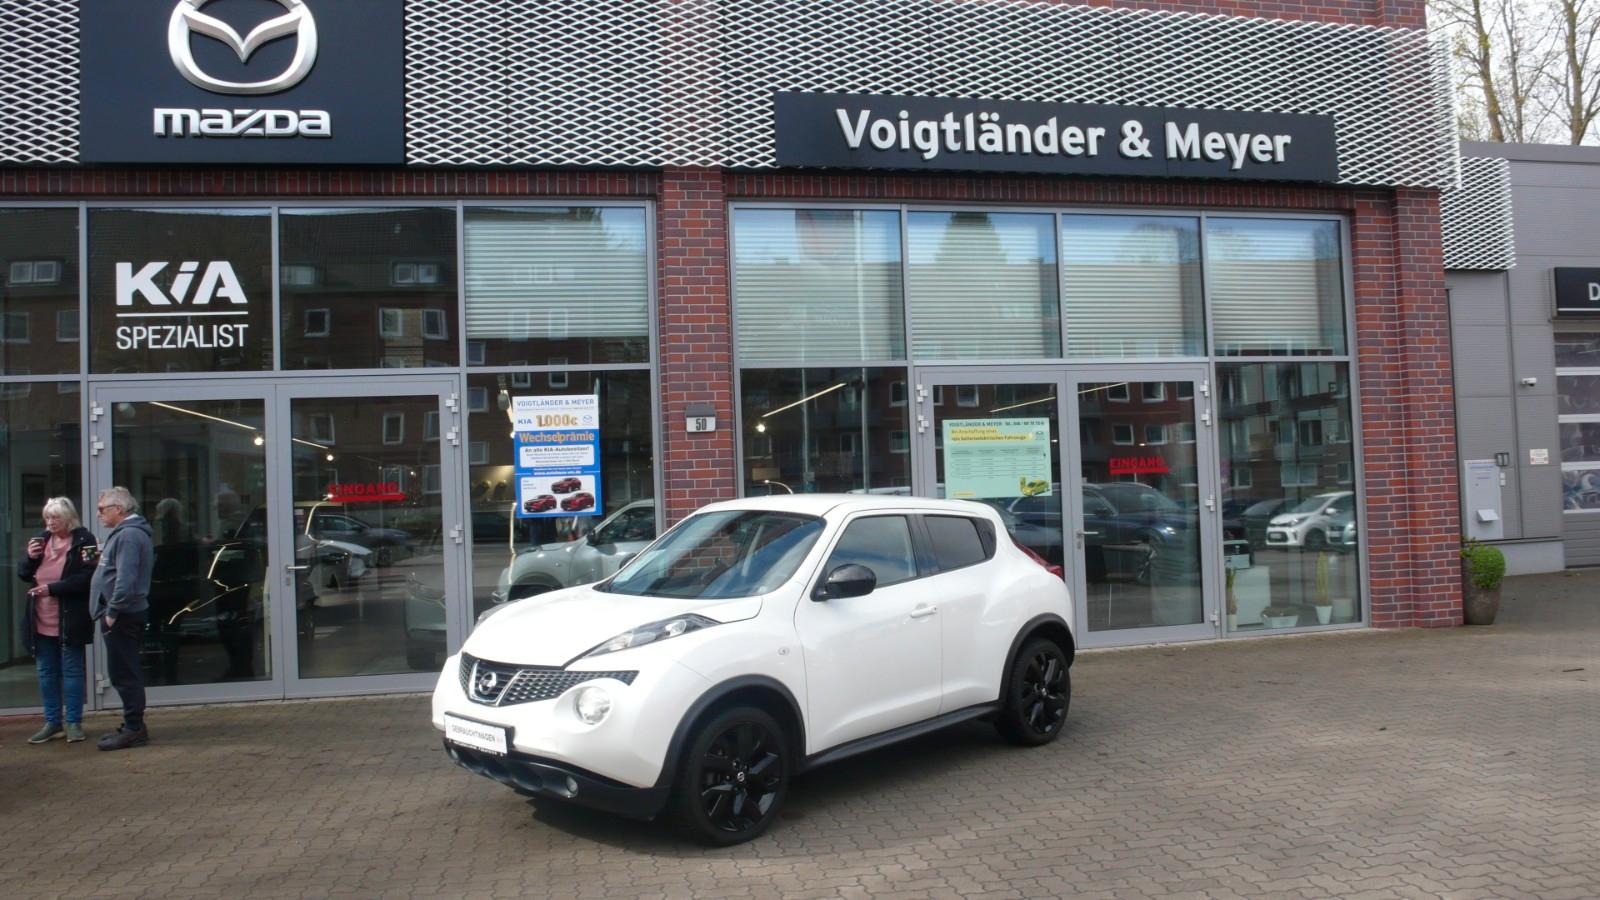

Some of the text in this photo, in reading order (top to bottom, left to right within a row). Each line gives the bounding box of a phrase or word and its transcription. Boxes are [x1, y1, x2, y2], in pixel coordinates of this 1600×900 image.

[153, 107, 332, 138] mazda
[835, 107, 1292, 171] Voigtländer & Meyer
[115, 323, 249, 350] SPEZIALIST
[695, 417, 707, 431] 50
[1109, 456, 1164, 467] EINGANG
